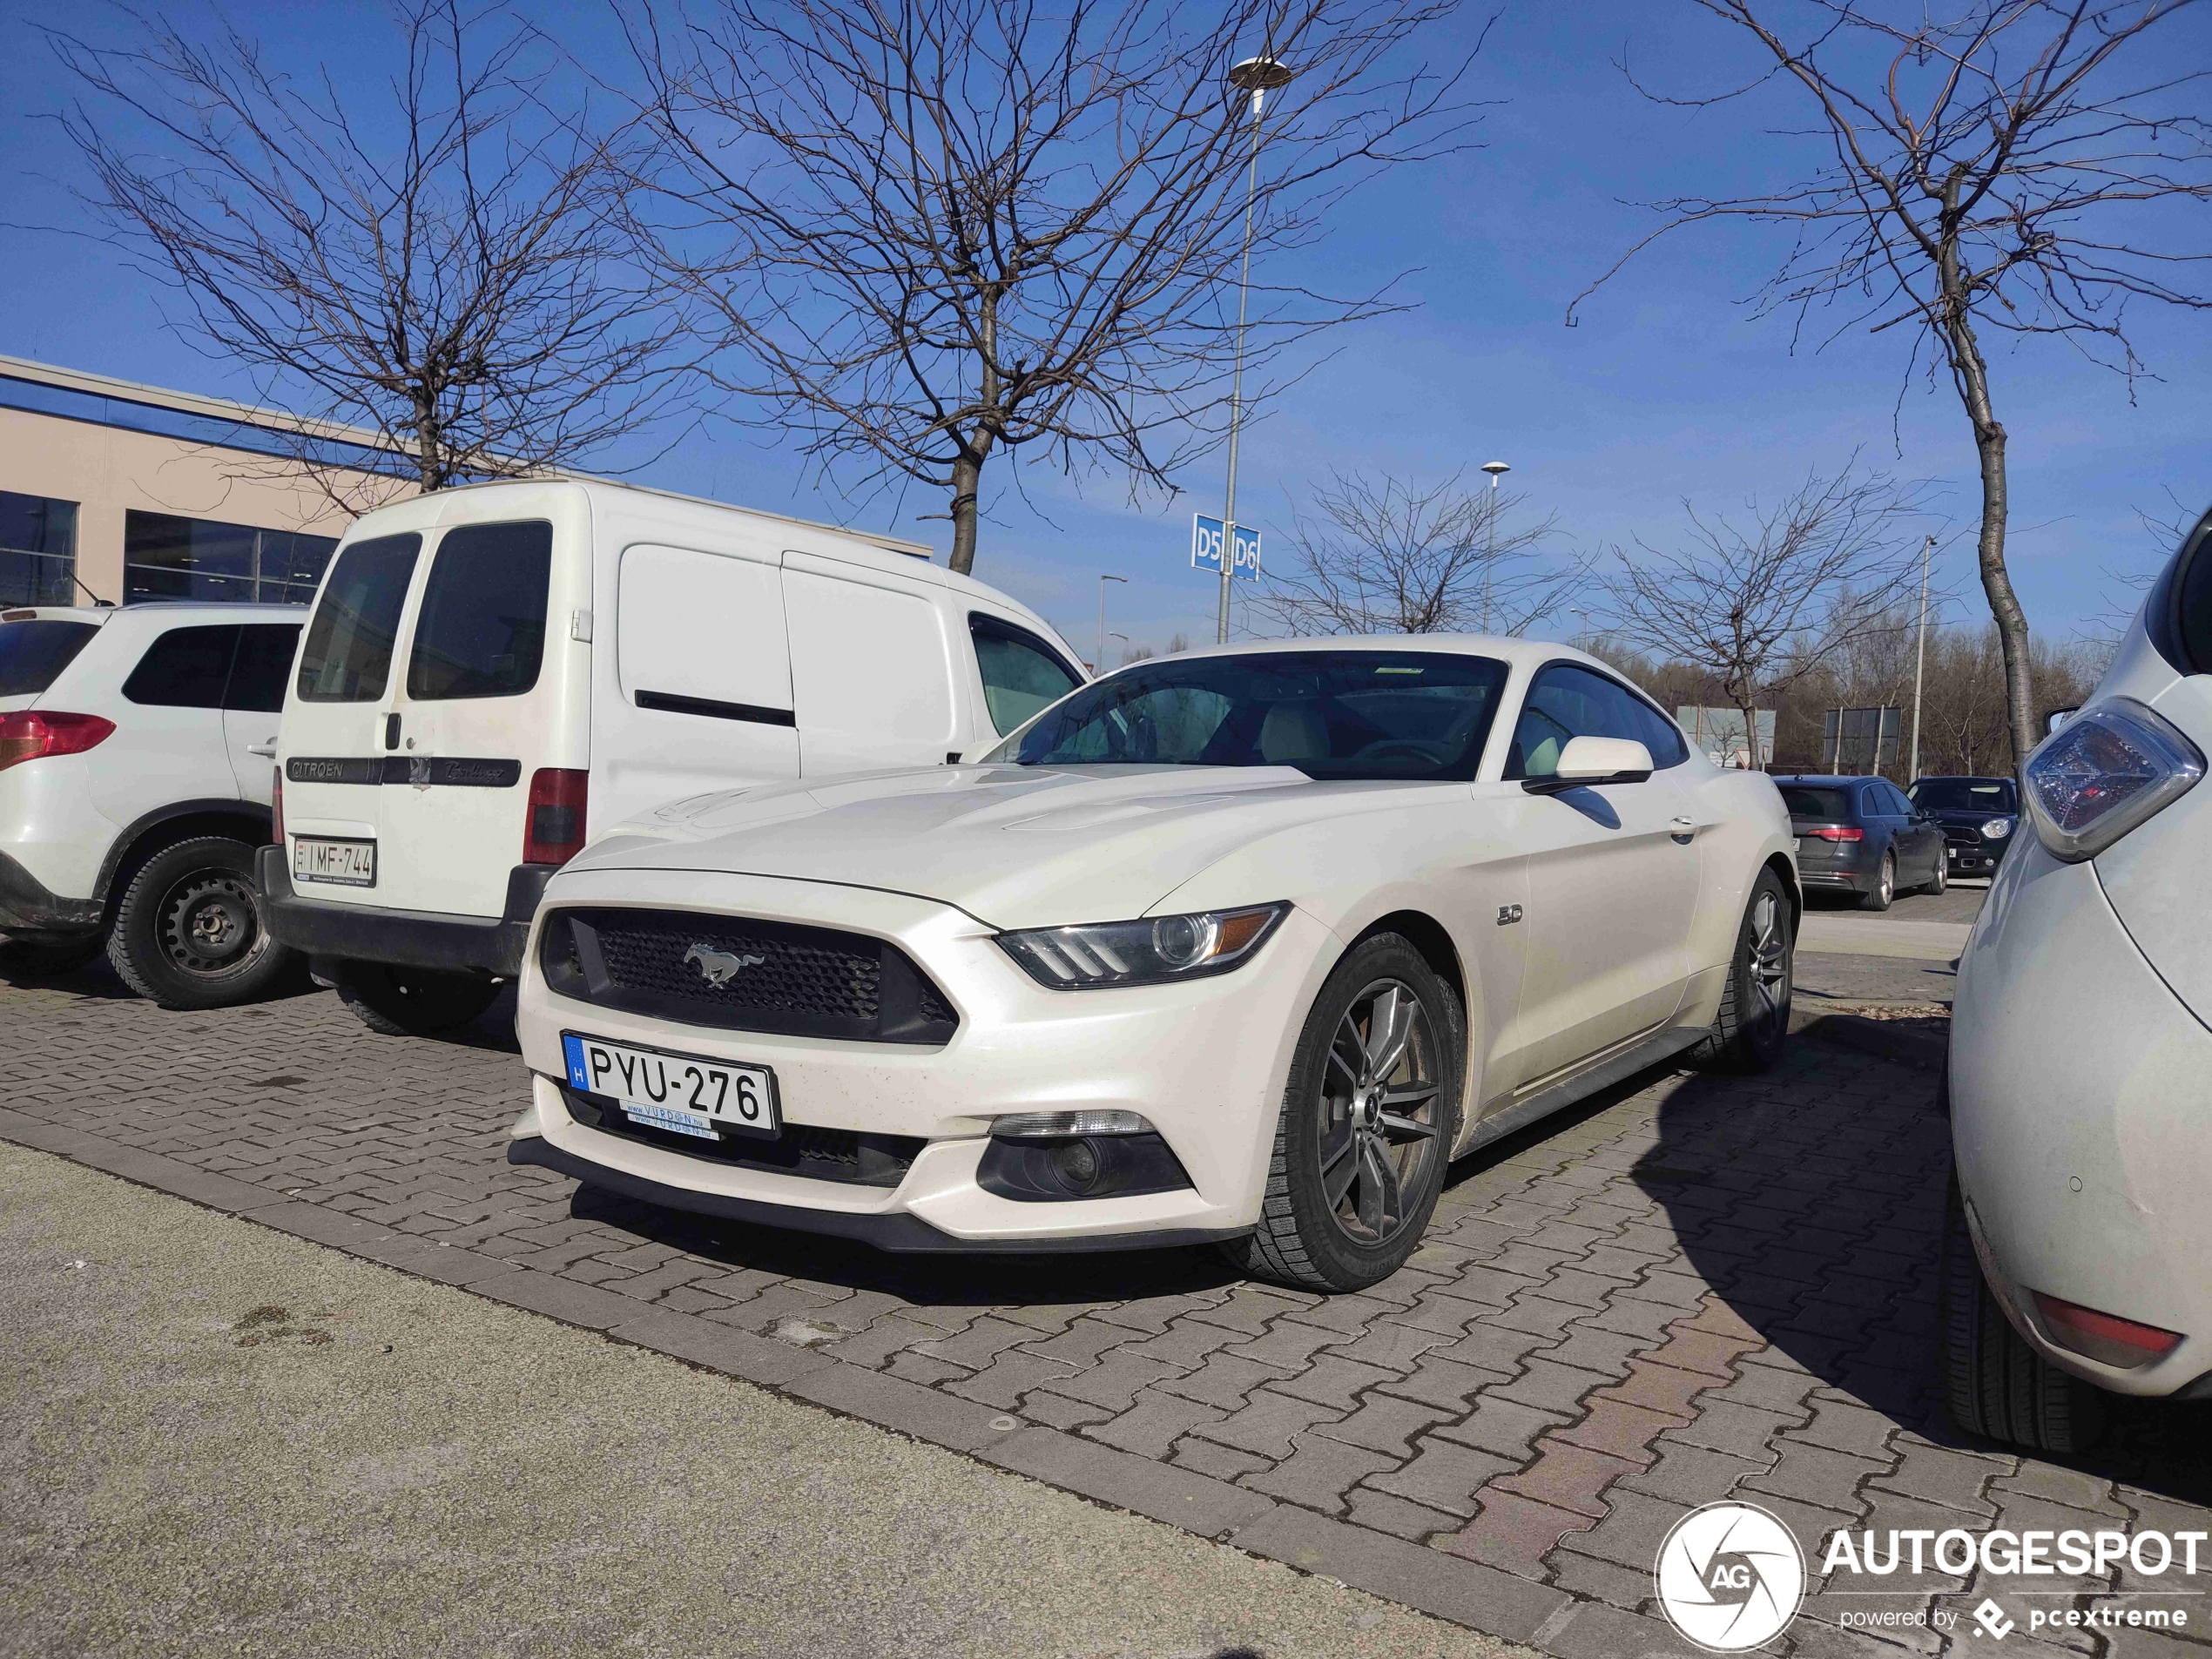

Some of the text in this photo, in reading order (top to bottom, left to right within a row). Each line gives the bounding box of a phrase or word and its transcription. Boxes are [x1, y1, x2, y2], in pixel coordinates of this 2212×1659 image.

[1197, 527, 1221, 560] D5
[1235, 536, 1257, 570] D6
[293, 759, 343, 778] CITROËN
[298, 858, 302, 869] H
[311, 846, 370, 875] IMF-744
[575, 1069, 583, 1082] H
[590, 1047, 759, 1121] PYU-276
